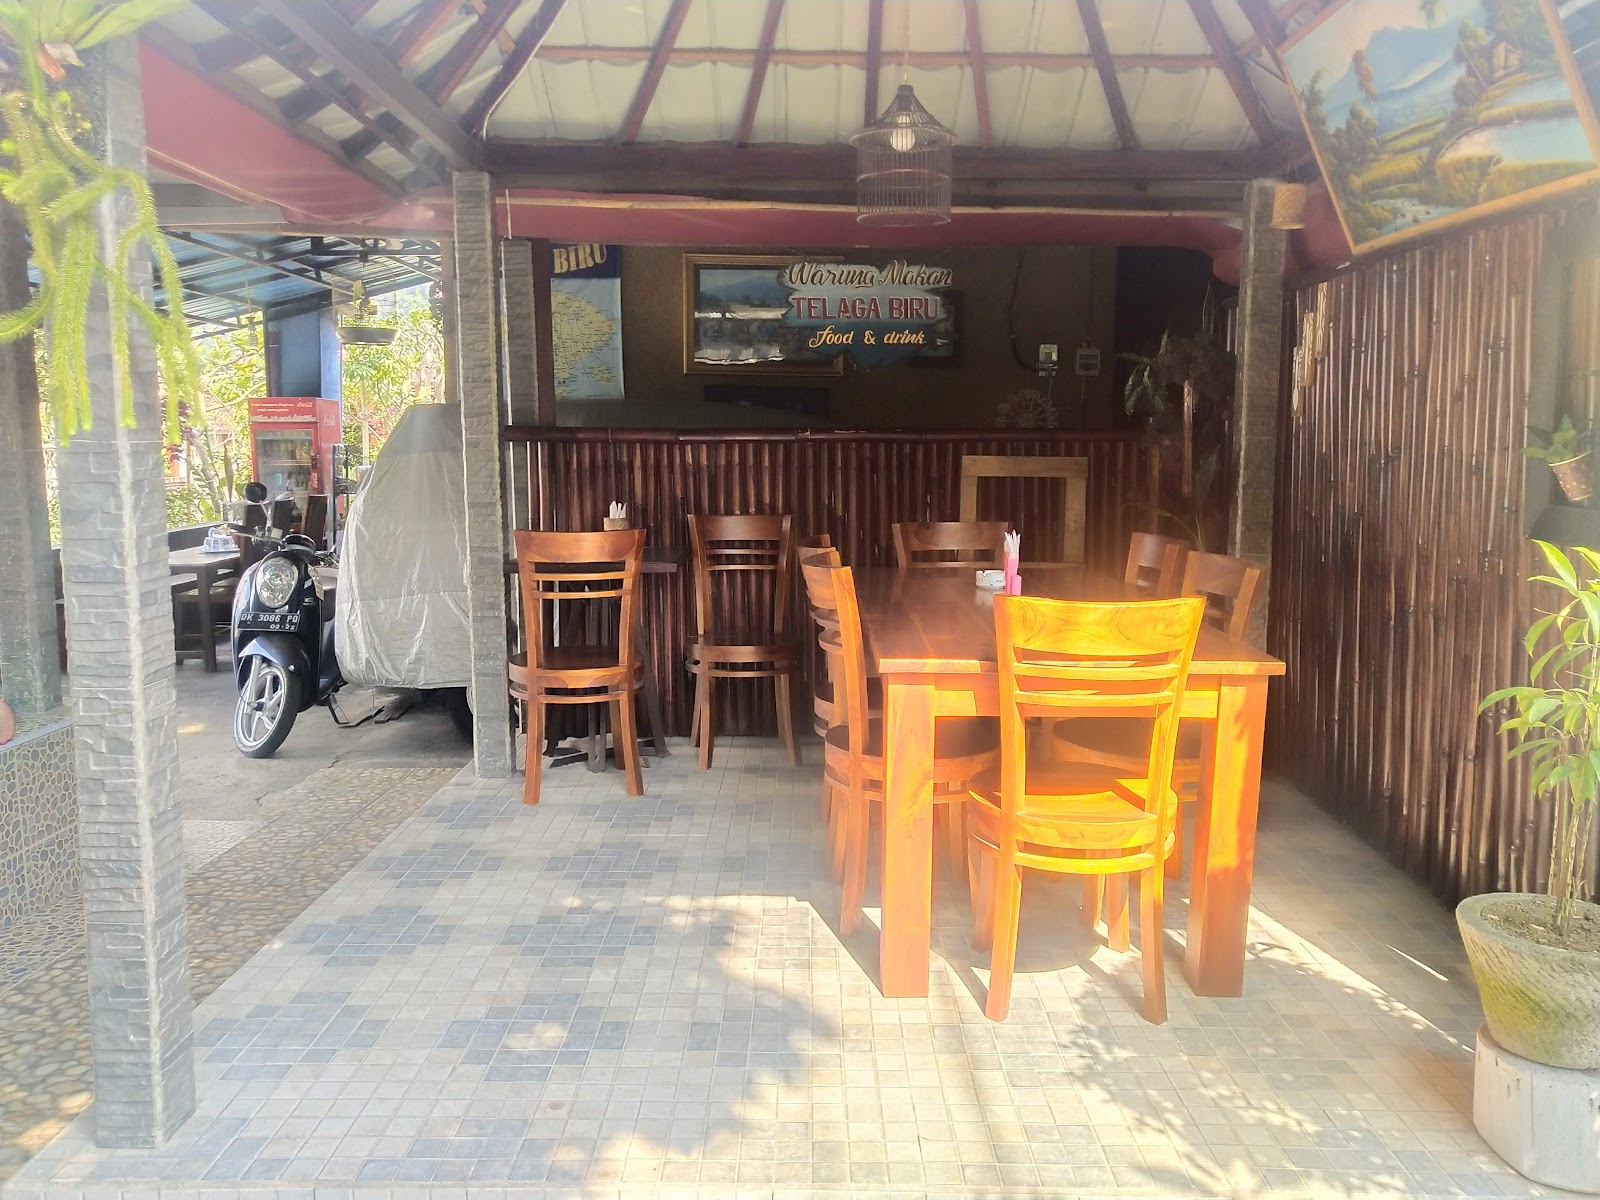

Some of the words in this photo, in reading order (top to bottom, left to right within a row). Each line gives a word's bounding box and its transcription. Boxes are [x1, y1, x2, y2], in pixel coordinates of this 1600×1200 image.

[553, 243, 607, 273] BIRU
[786, 262, 877, 288] Warung
[879, 260, 953, 287] Makan
[792, 296, 882, 320] TELAGA
[888, 296, 940, 320] BIRU
[808, 325, 855, 348] food
[863, 330, 877, 345] &
[883, 329, 925, 345] drink
[240, 613, 254, 621] DK
[257, 614, 281, 622] 3086
